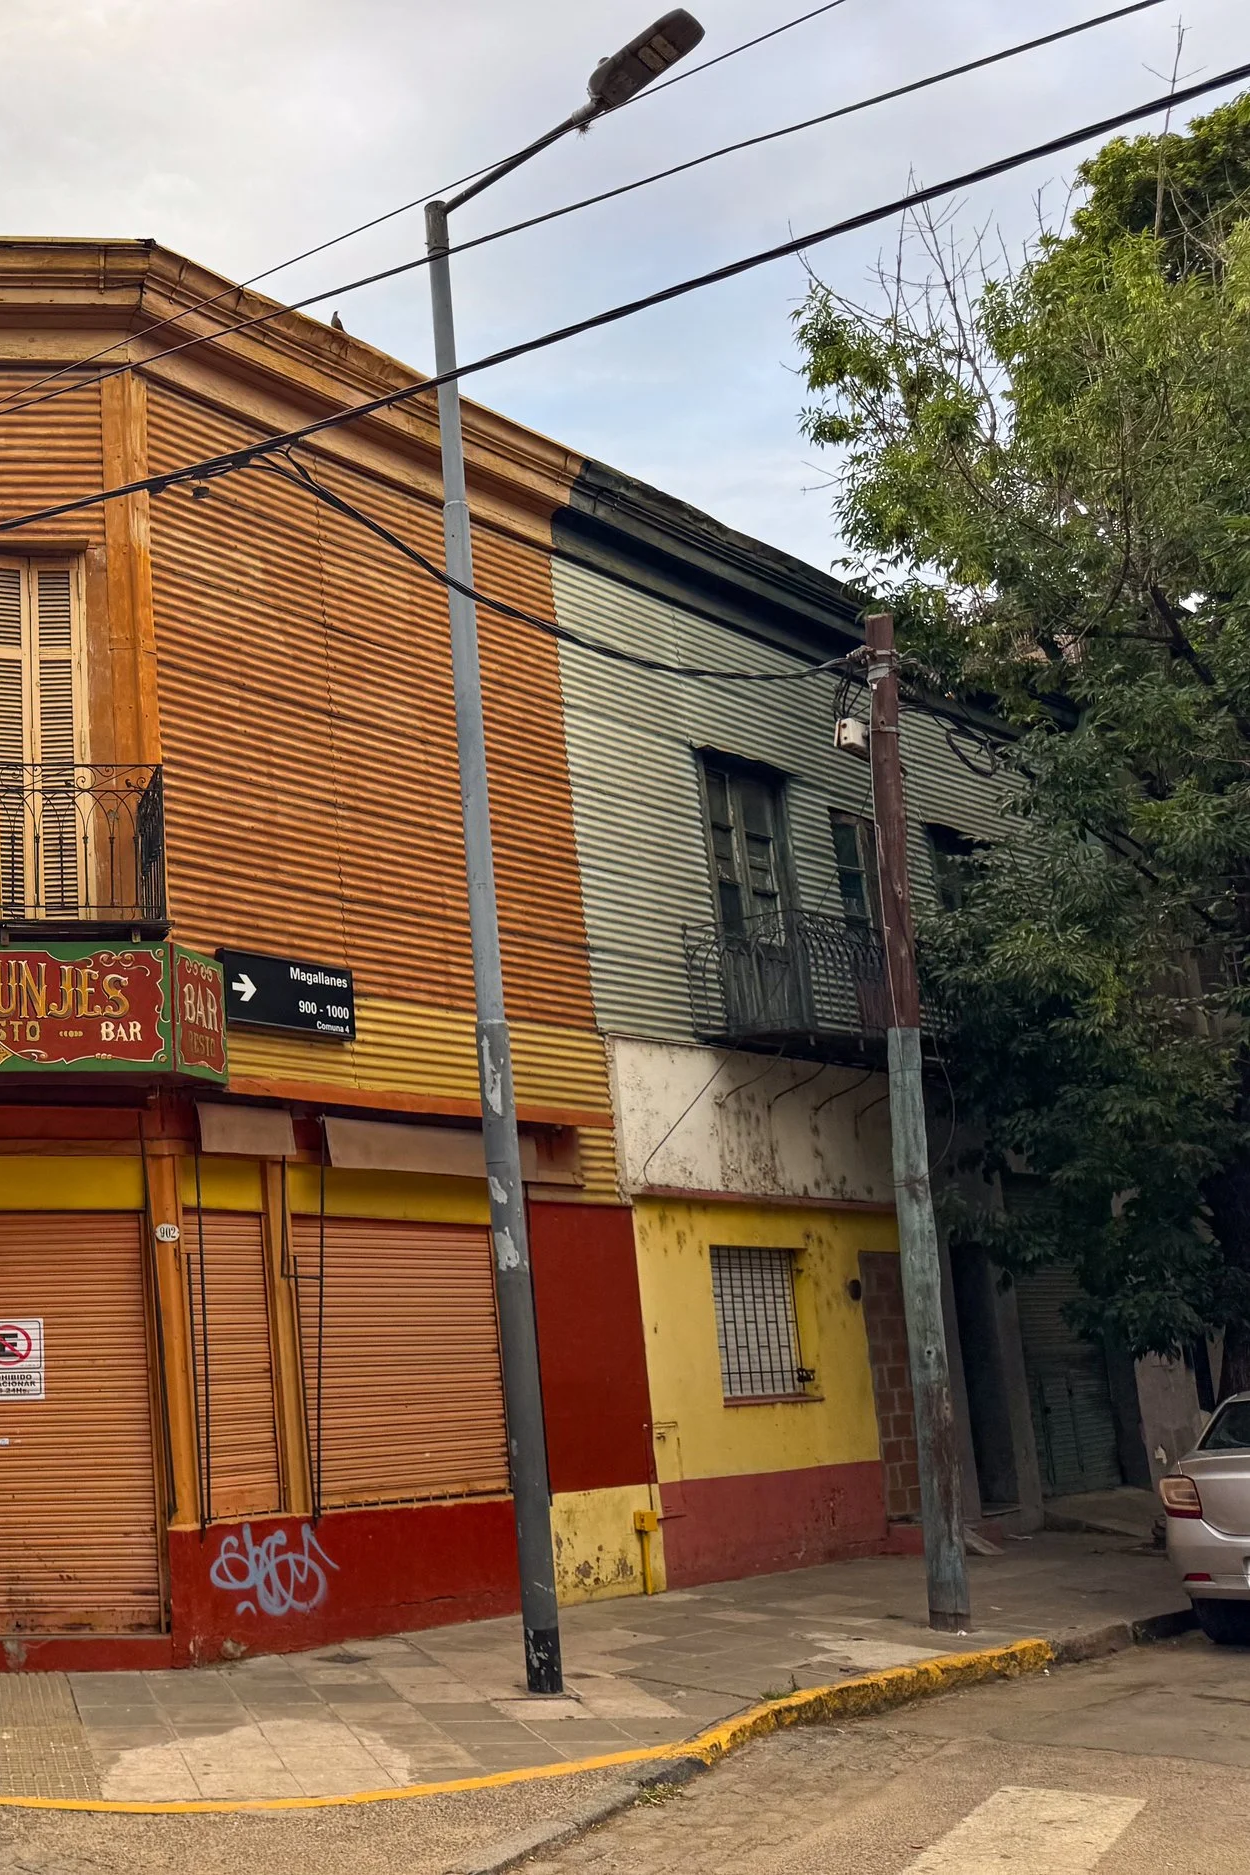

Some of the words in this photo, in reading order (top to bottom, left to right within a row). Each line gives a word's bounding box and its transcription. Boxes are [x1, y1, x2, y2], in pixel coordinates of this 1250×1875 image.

[289, 966, 348, 988] Magallanes
[183, 983, 219, 1033] BAR
[298, 1000, 317, 1015] 900
[326, 1004, 350, 1020] 1000
[101, 1021, 142, 1042] BAR
[316, 1020, 345, 1033] Comuna
[345, 1025, 350, 1034] 4
[188, 1031, 216, 1058] RESTO
[159, 1227, 177, 1239] 902
